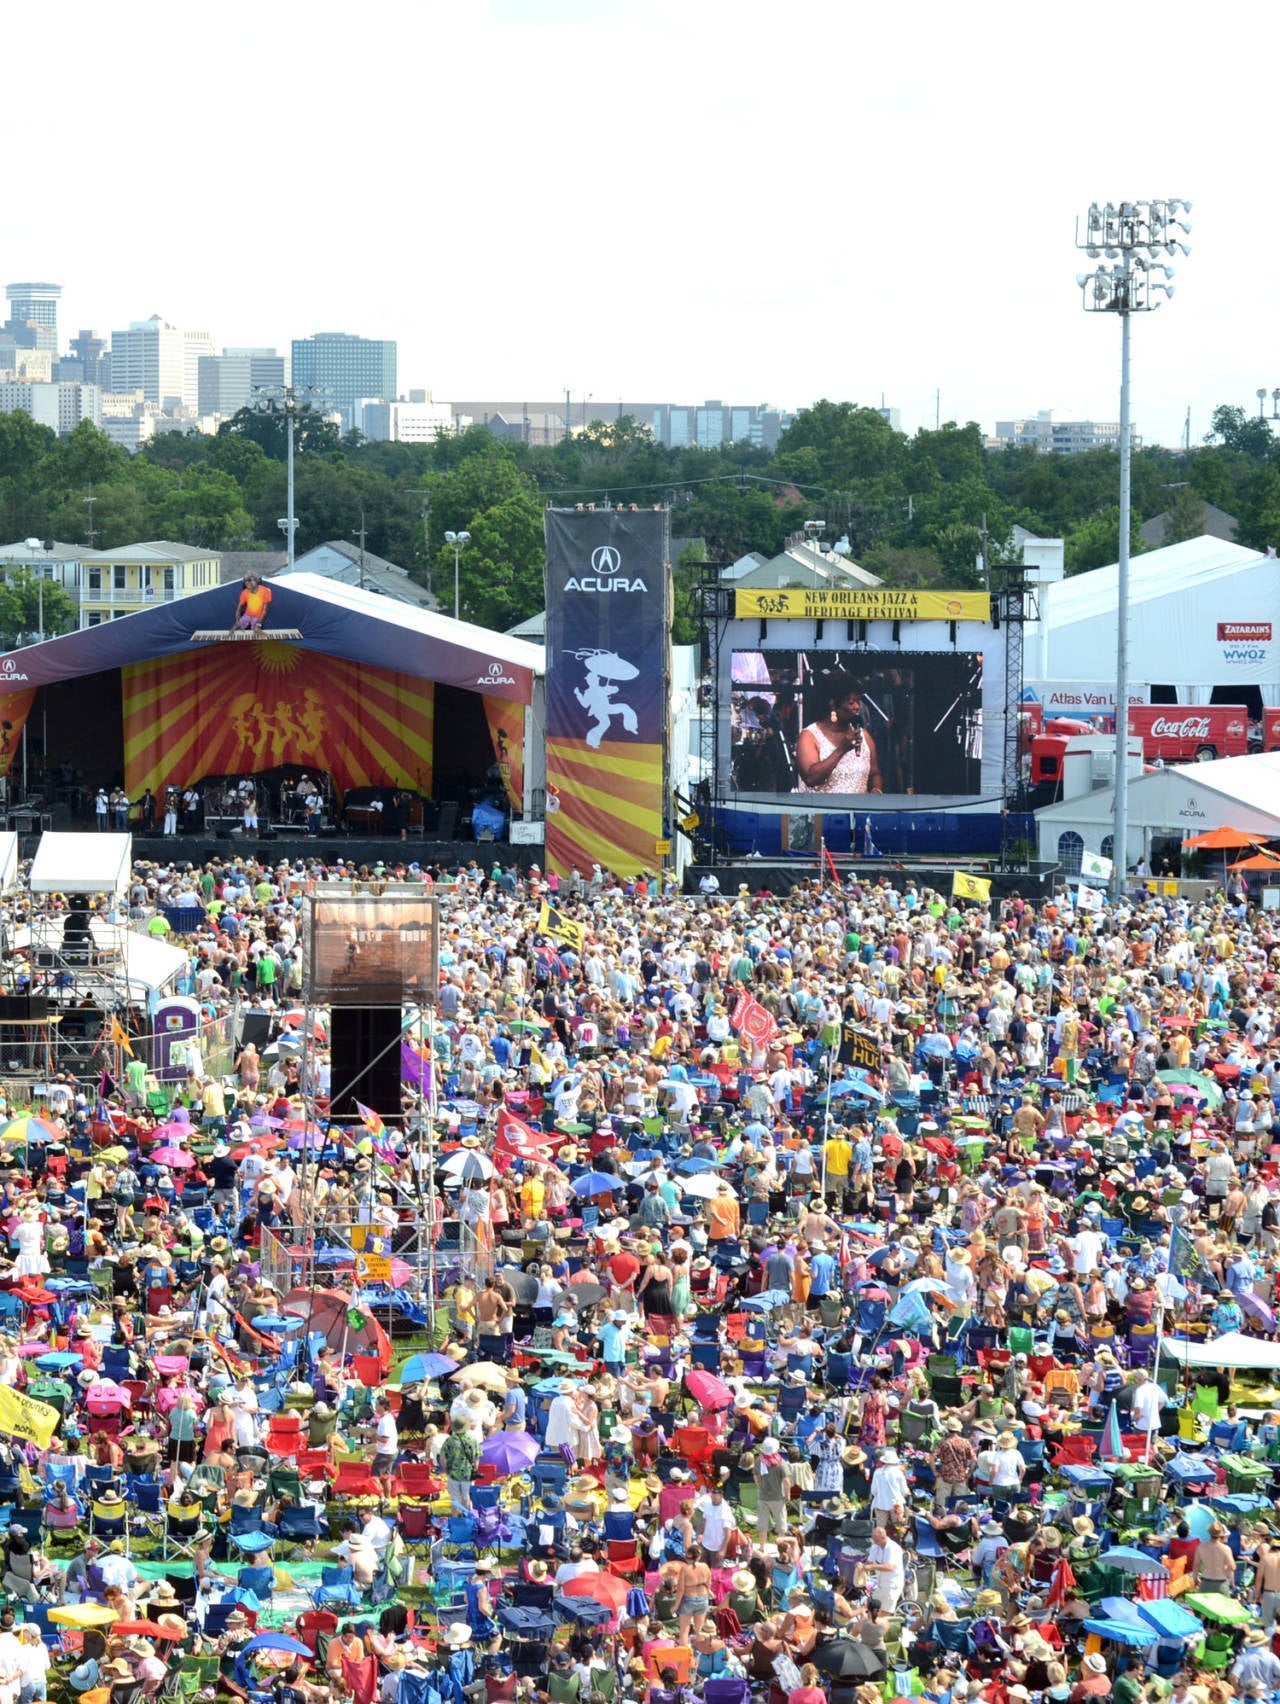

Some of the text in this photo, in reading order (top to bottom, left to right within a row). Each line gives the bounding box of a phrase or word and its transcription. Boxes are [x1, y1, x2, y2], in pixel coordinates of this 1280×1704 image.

[563, 577, 648, 593] ACURA
[804, 591, 918, 605] NEW ORLEANS JAZZ &
[804, 606, 919, 618] HERITAGE FESTIVAL
[1223, 649, 1266, 659] WWOZ
[476, 676, 516, 685] ACURA
[1050, 692, 1144, 705] Atlas Van Les
[1151, 717, 1211, 738] Coca-Cola
[1178, 810, 1207, 818] ACURA
